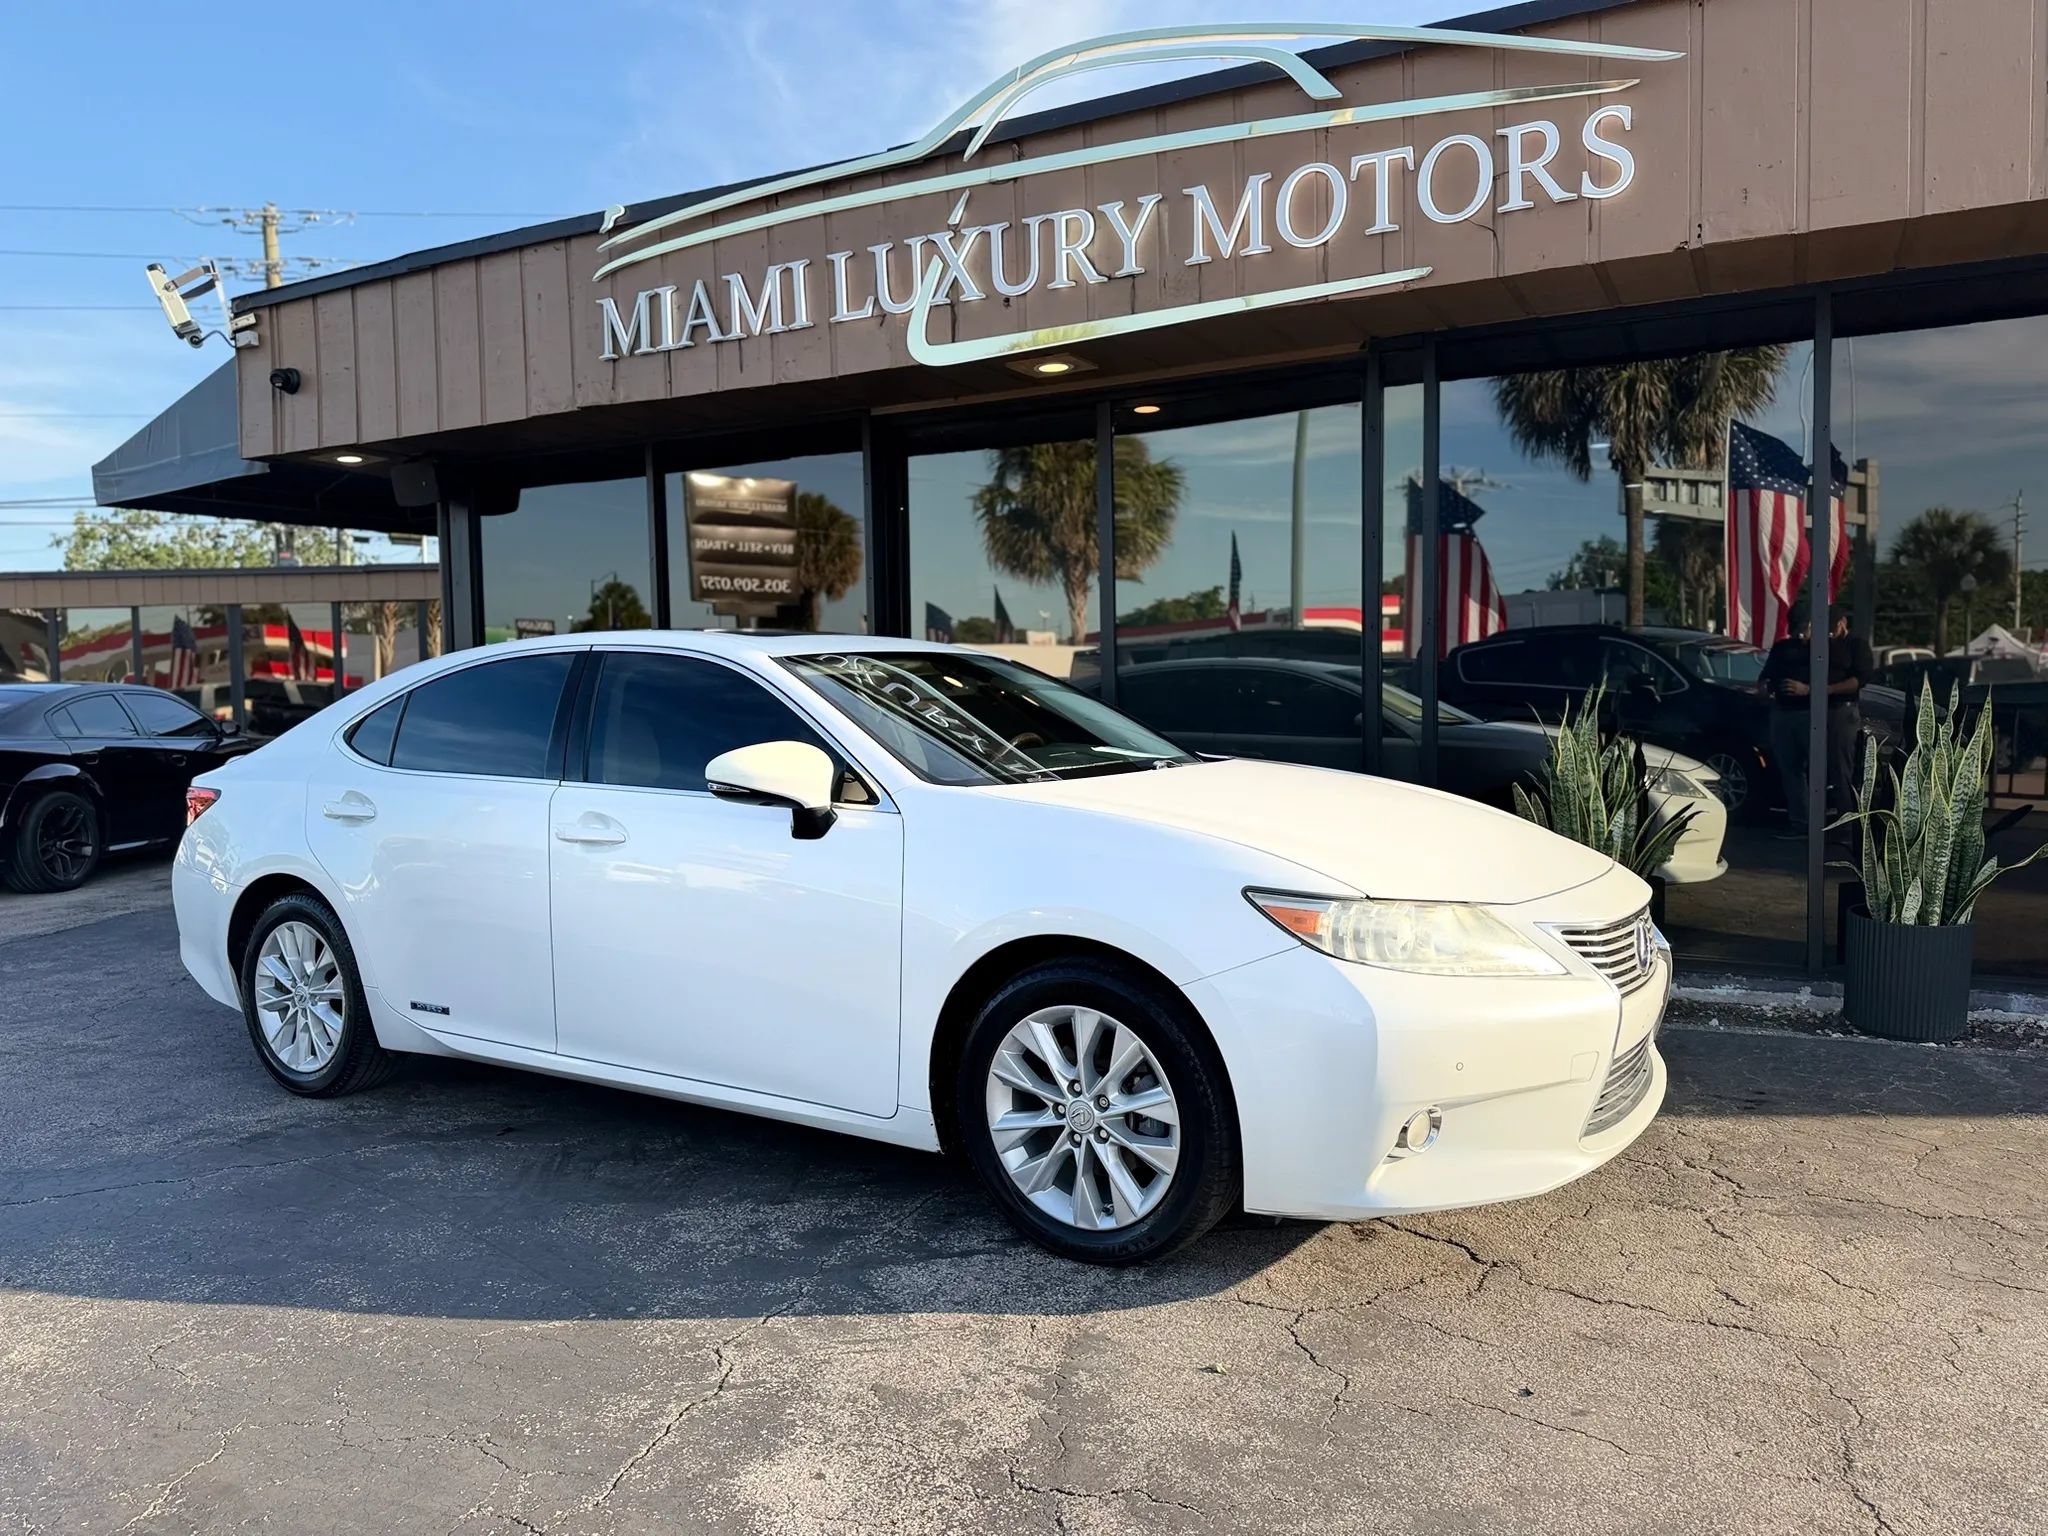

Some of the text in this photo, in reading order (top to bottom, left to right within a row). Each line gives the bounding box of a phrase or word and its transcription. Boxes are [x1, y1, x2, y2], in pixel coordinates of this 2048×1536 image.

[596, 105, 1636, 361] MIAMI LUXURY MOTORS
